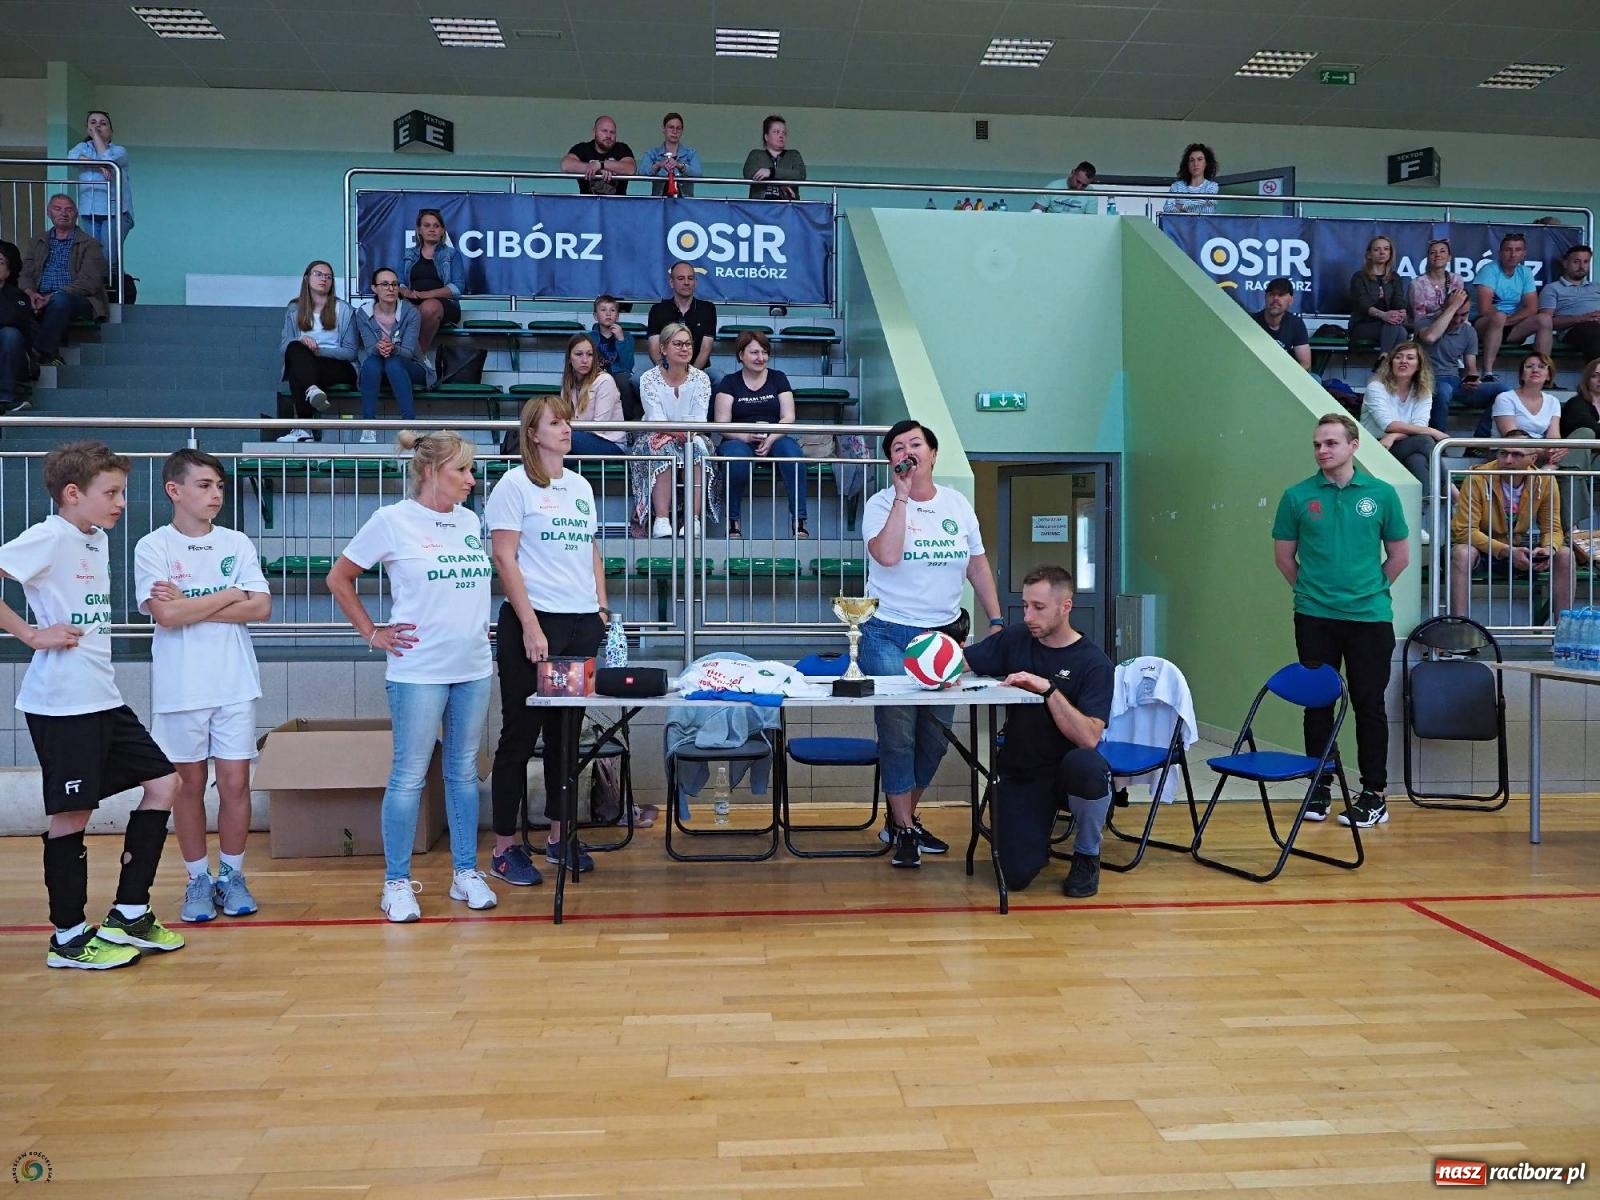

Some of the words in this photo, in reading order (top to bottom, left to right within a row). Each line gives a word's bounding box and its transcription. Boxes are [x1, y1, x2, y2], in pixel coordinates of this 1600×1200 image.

[399, 123, 410, 145] E
[426, 124, 445, 147] E
[1401, 160, 1420, 178] F
[715, 265, 788, 279] RACIBÓRZ
[552, 518, 588, 528] GRAMY
[541, 532, 566, 541] DLA
[914, 540, 956, 548] GRAMY
[437, 554, 484, 563] GRAMY
[903, 551, 930, 561] DLA
[933, 550, 968, 559] MAMY
[427, 567, 457, 581] DLA
